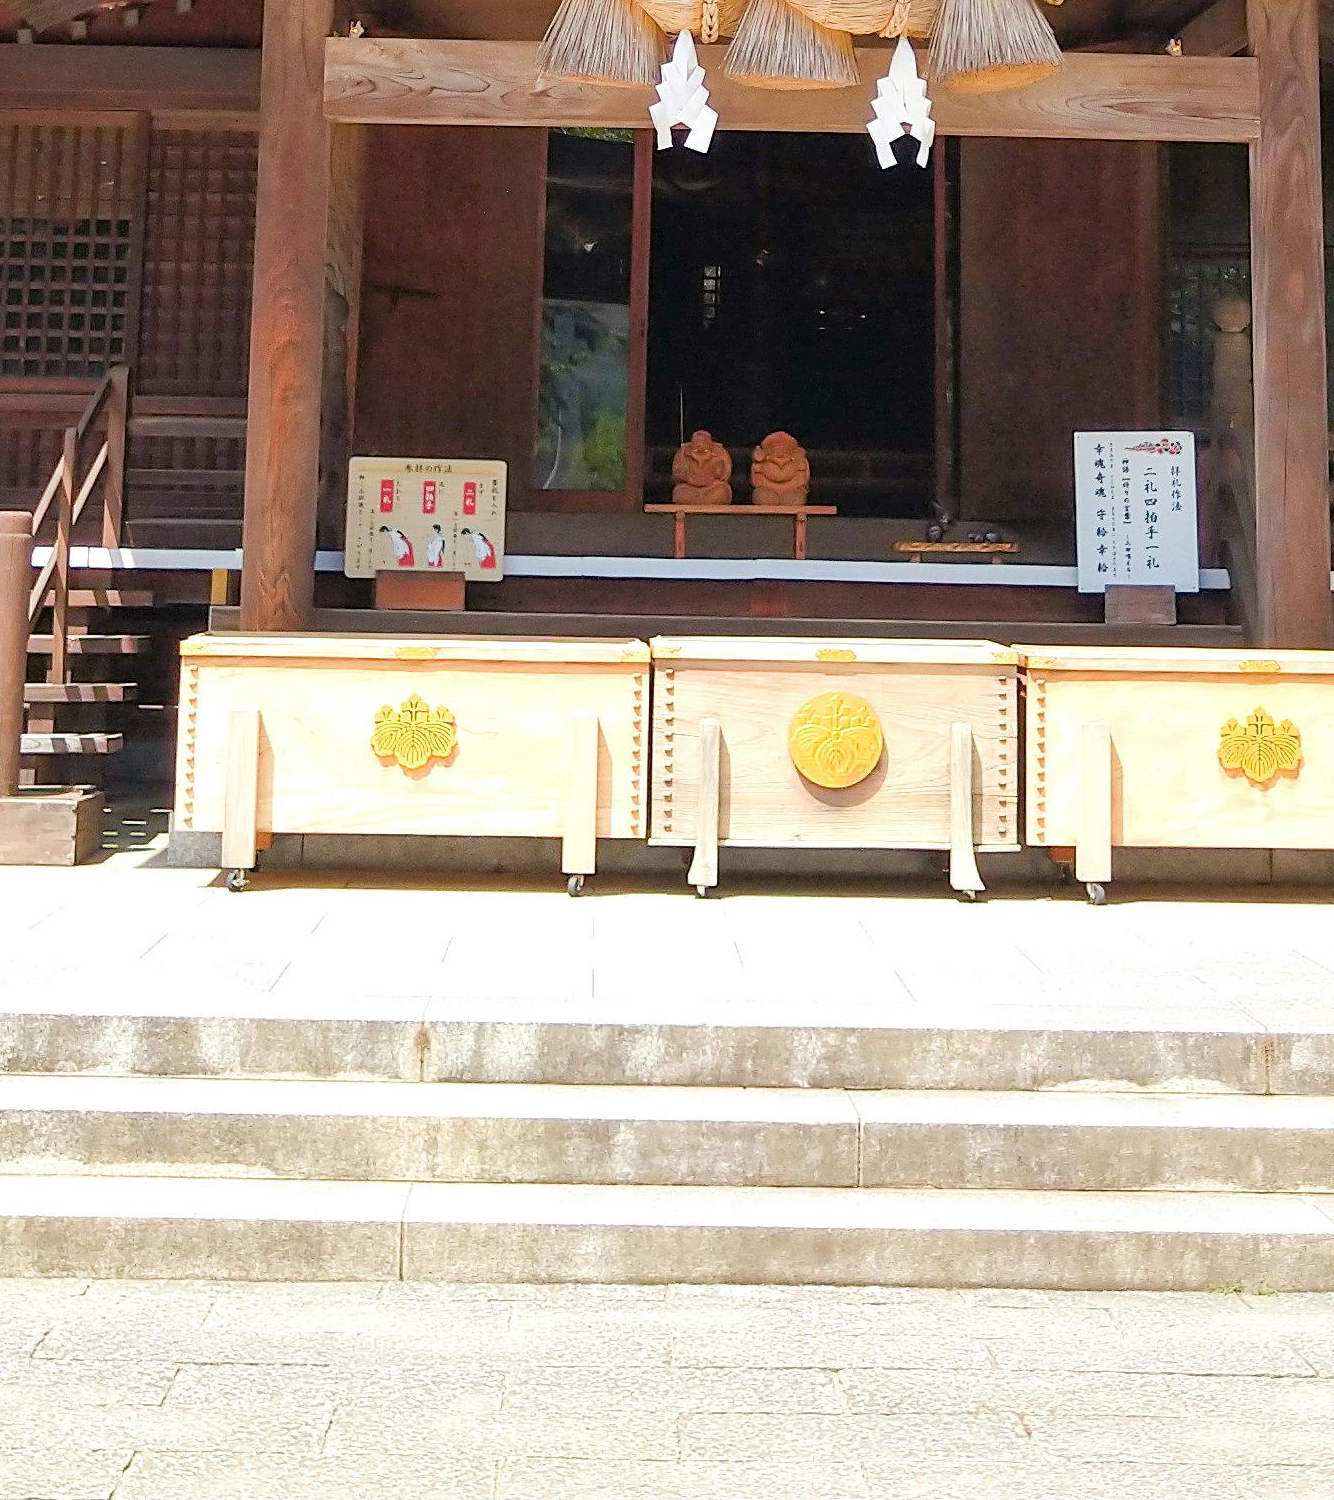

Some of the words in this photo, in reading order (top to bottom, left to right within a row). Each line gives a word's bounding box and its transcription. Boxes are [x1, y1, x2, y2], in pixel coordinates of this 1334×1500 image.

[1143, 466, 1160, 570] 二礼四拍手一礼
[1170, 465, 1183, 512] 拝礼作法
